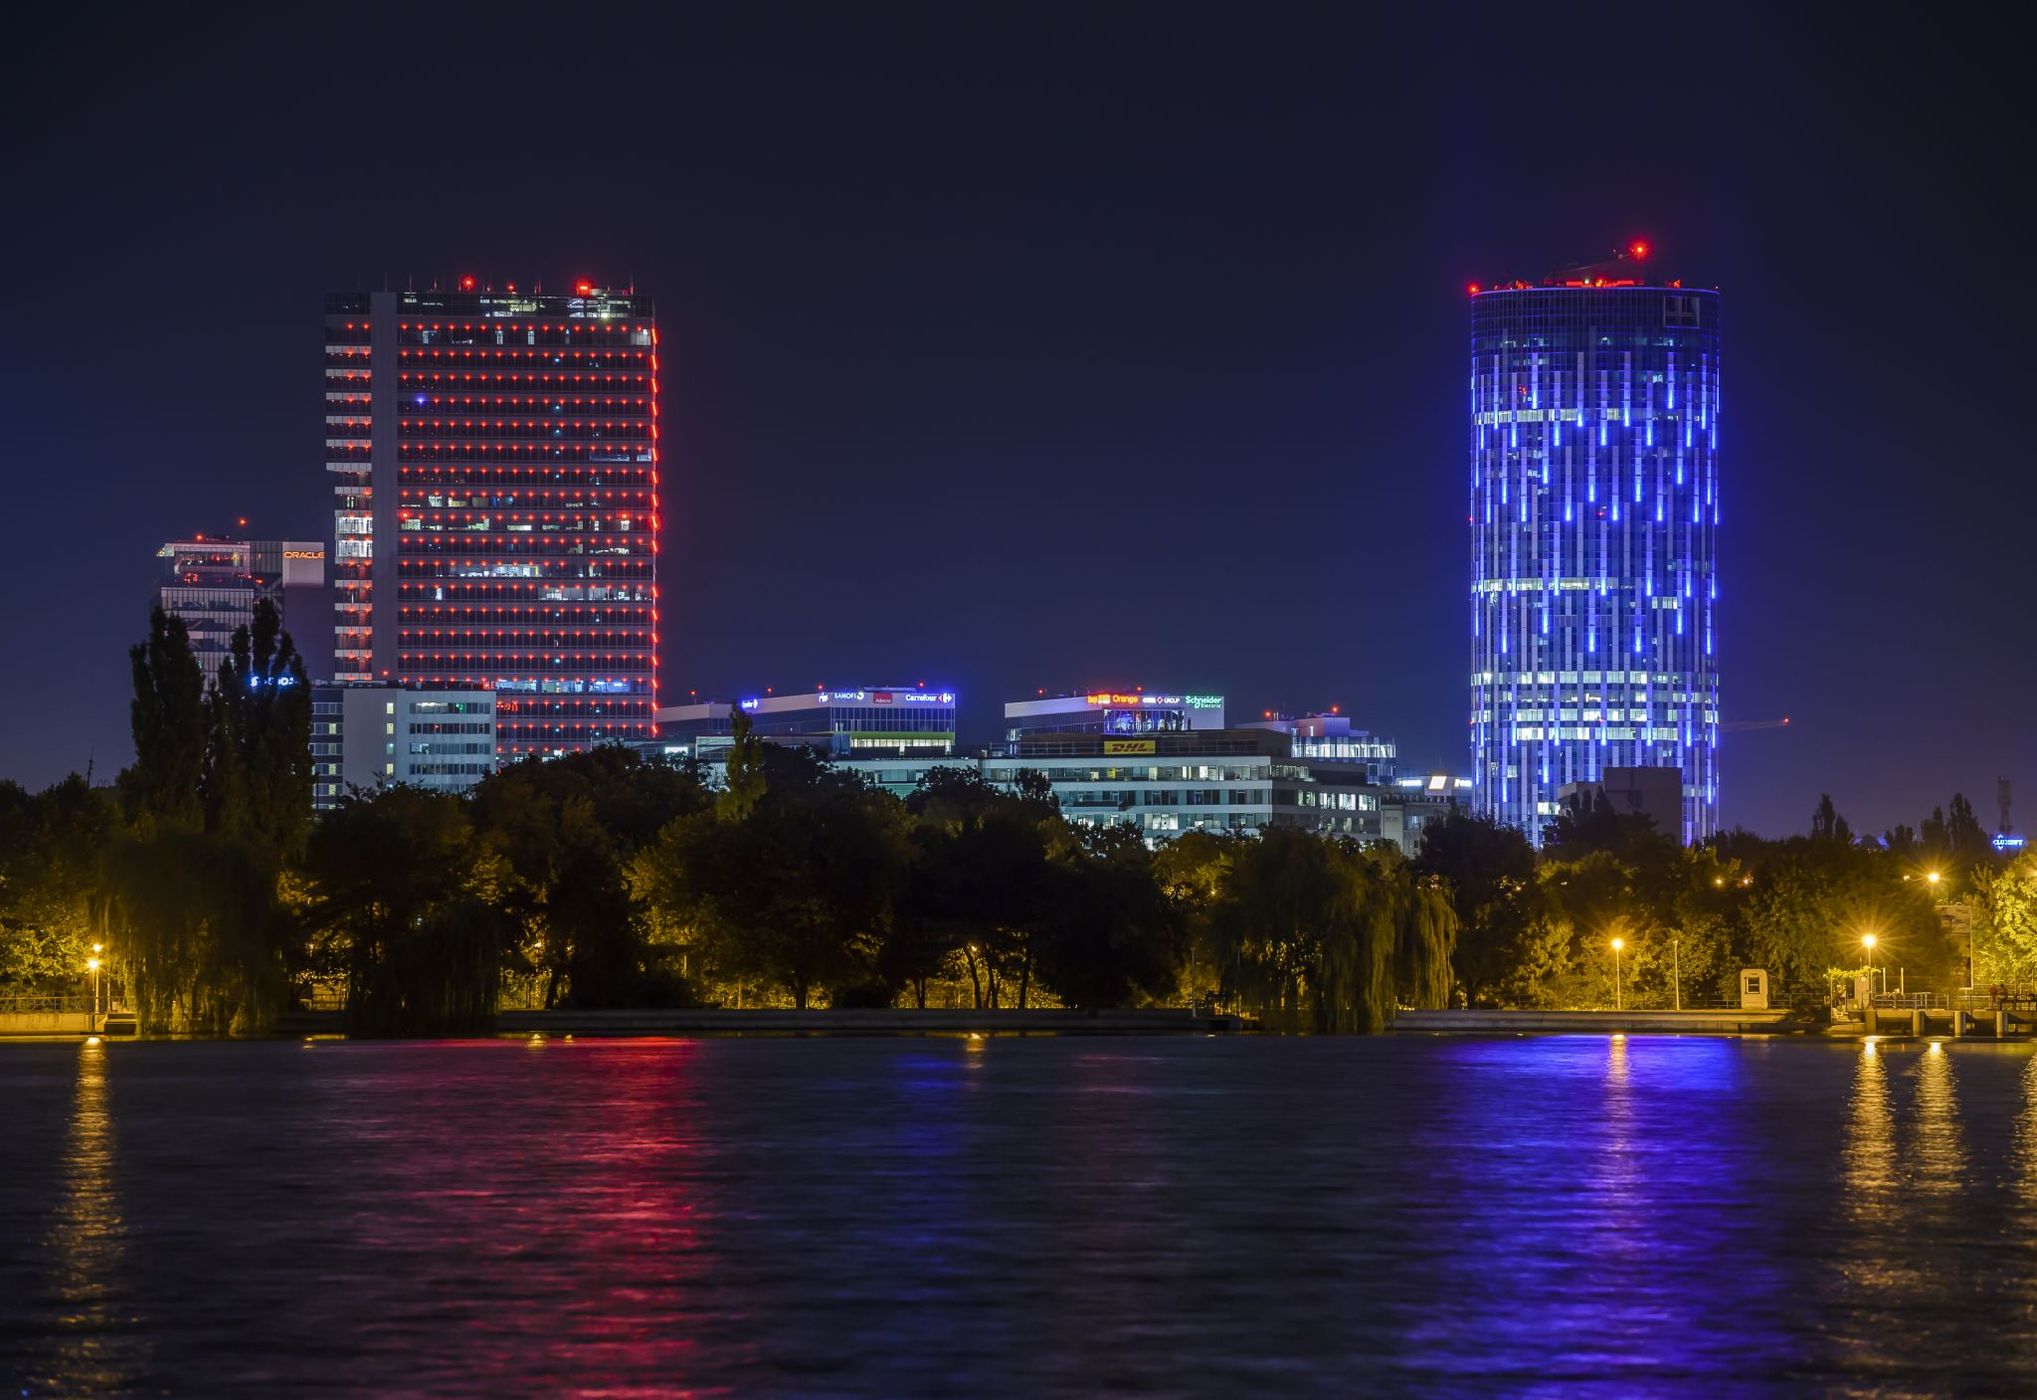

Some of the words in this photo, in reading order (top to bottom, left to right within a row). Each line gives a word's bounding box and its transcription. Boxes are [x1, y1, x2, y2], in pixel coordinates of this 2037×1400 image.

[283, 551, 325, 559] ORACLE
[905, 694, 937, 702] Carrefour
[1185, 695, 1221, 708] Schneider
[1111, 743, 1148, 752] DHL
